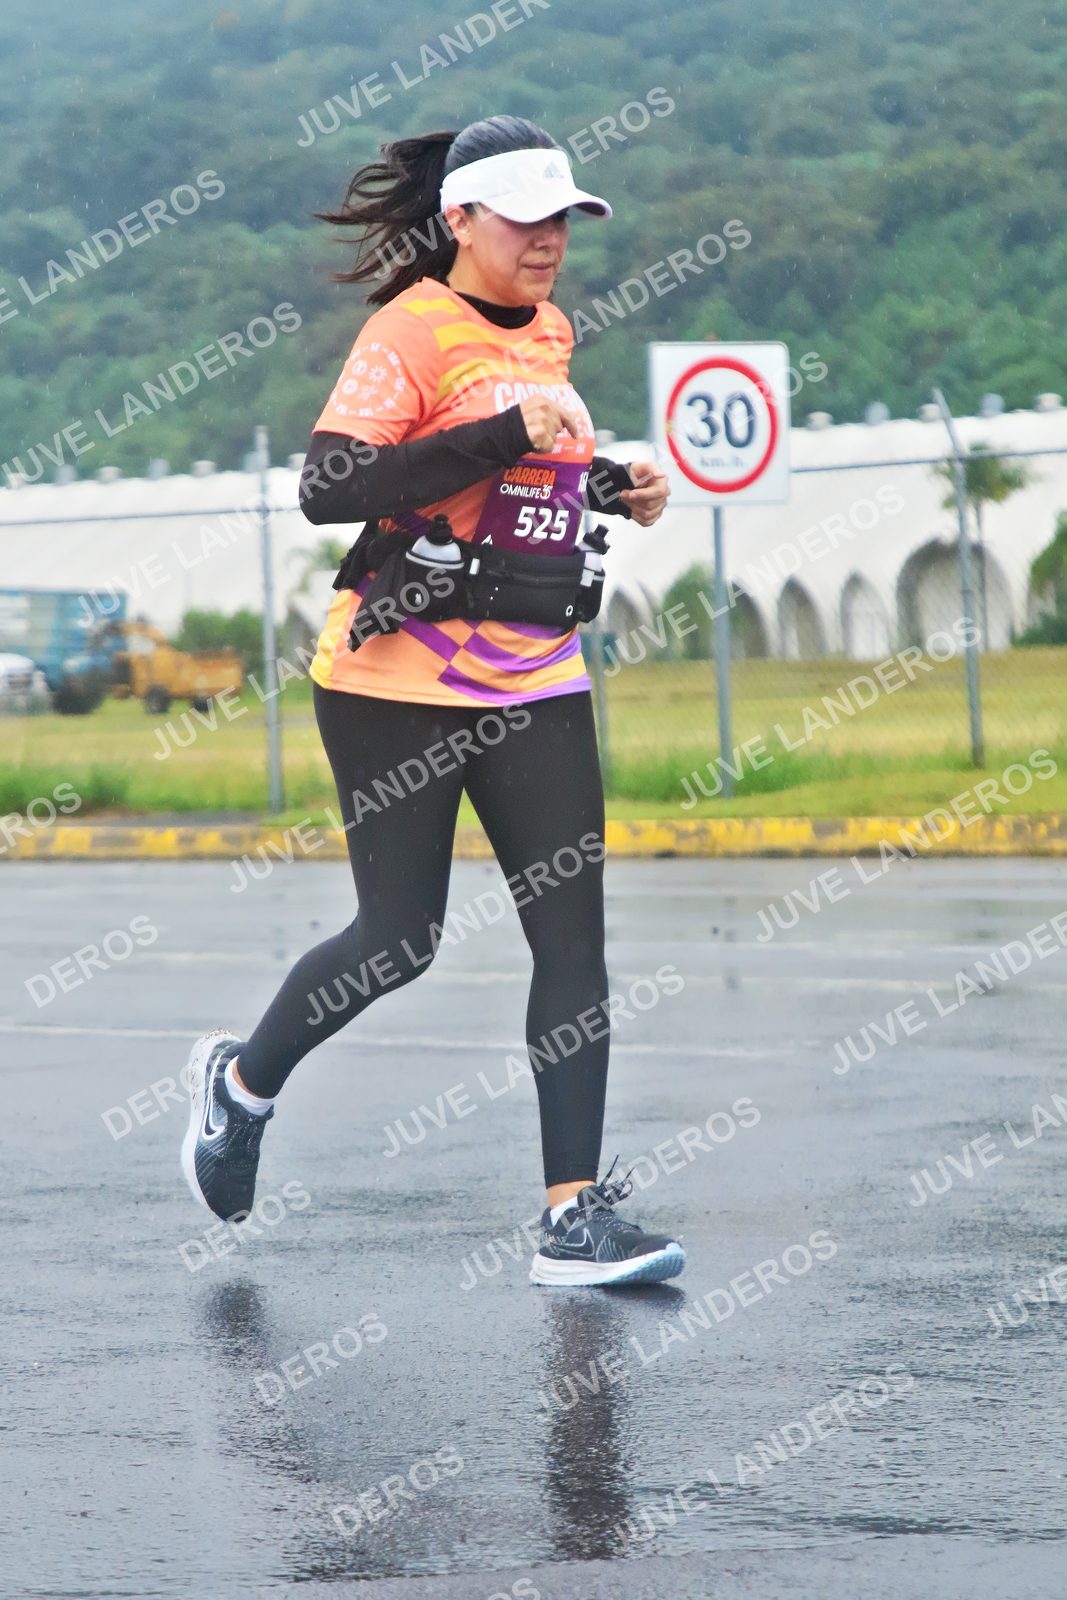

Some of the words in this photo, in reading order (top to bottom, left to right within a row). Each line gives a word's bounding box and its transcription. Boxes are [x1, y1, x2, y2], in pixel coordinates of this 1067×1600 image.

[687, 391, 756, 448] 30
[503, 466, 557, 487] CARRERA
[513, 505, 570, 541] 525
